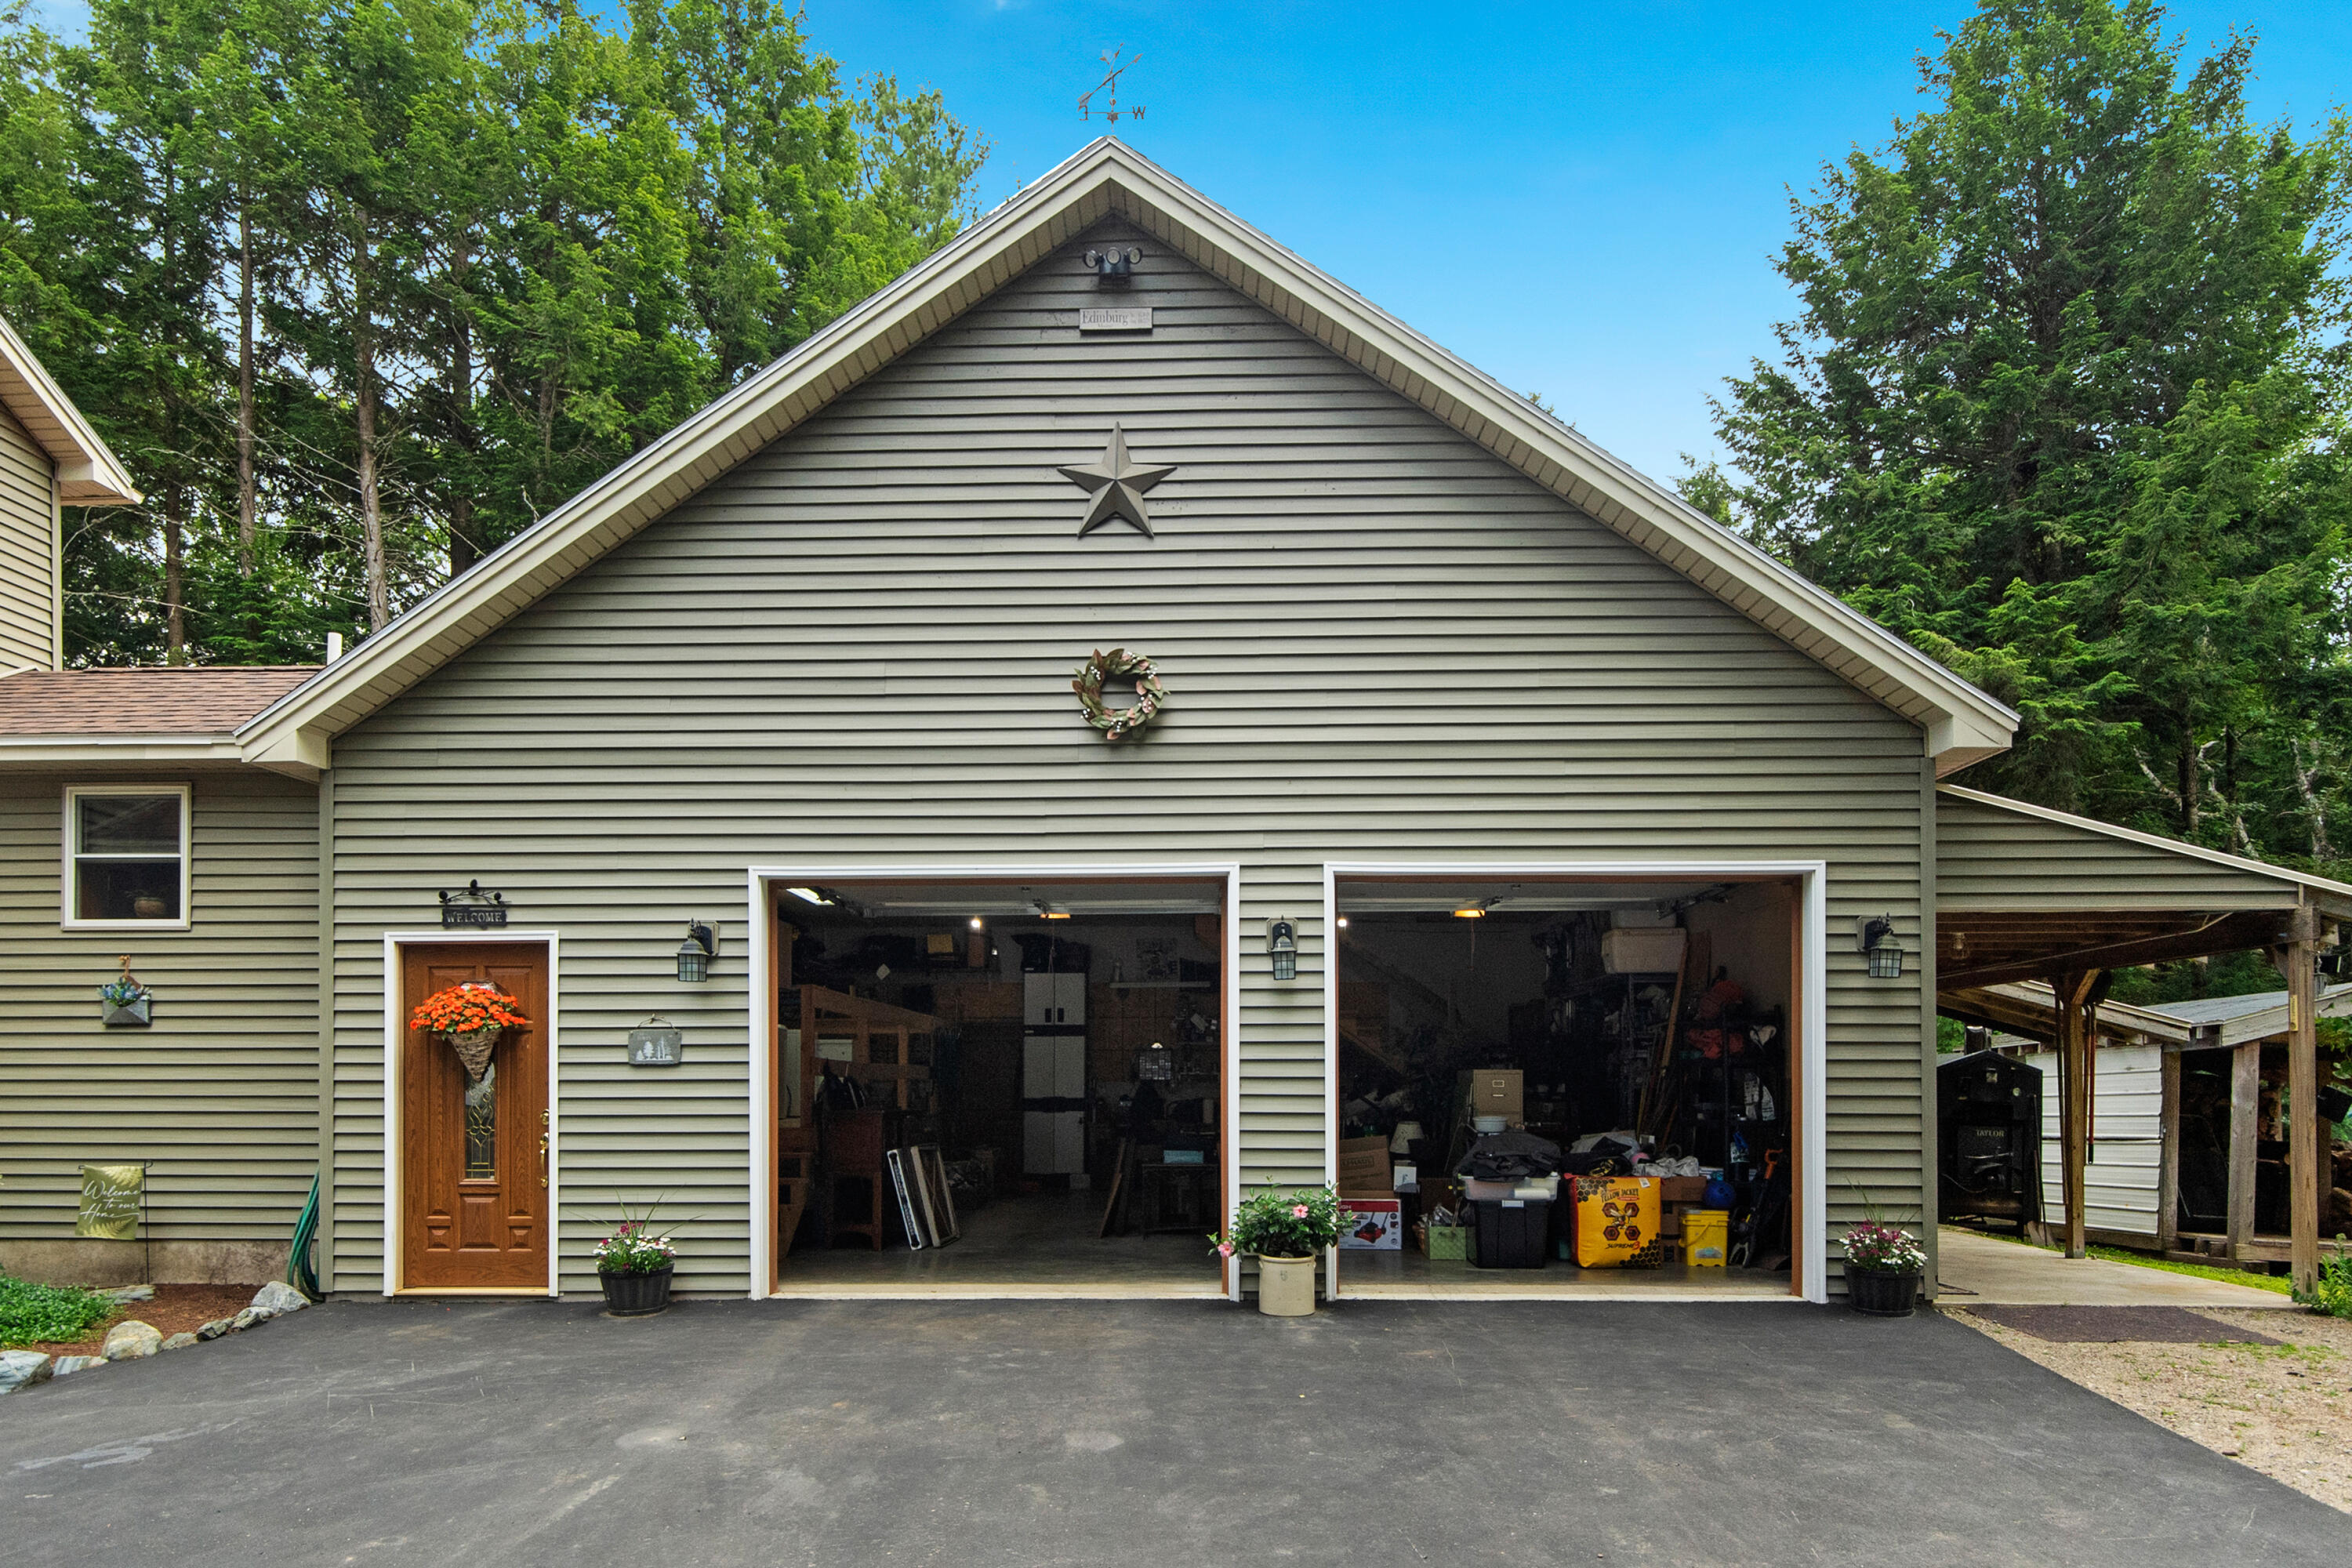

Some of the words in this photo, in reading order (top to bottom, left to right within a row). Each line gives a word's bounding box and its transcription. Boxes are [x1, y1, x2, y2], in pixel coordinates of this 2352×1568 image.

[446, 912, 503, 923] WELCOME
[1976, 1129, 2005, 1138] TAYLOR
[84, 1180, 140, 1200] Welcome
[103, 1197, 122, 1210] to
[79, 1203, 140, 1223] Home
